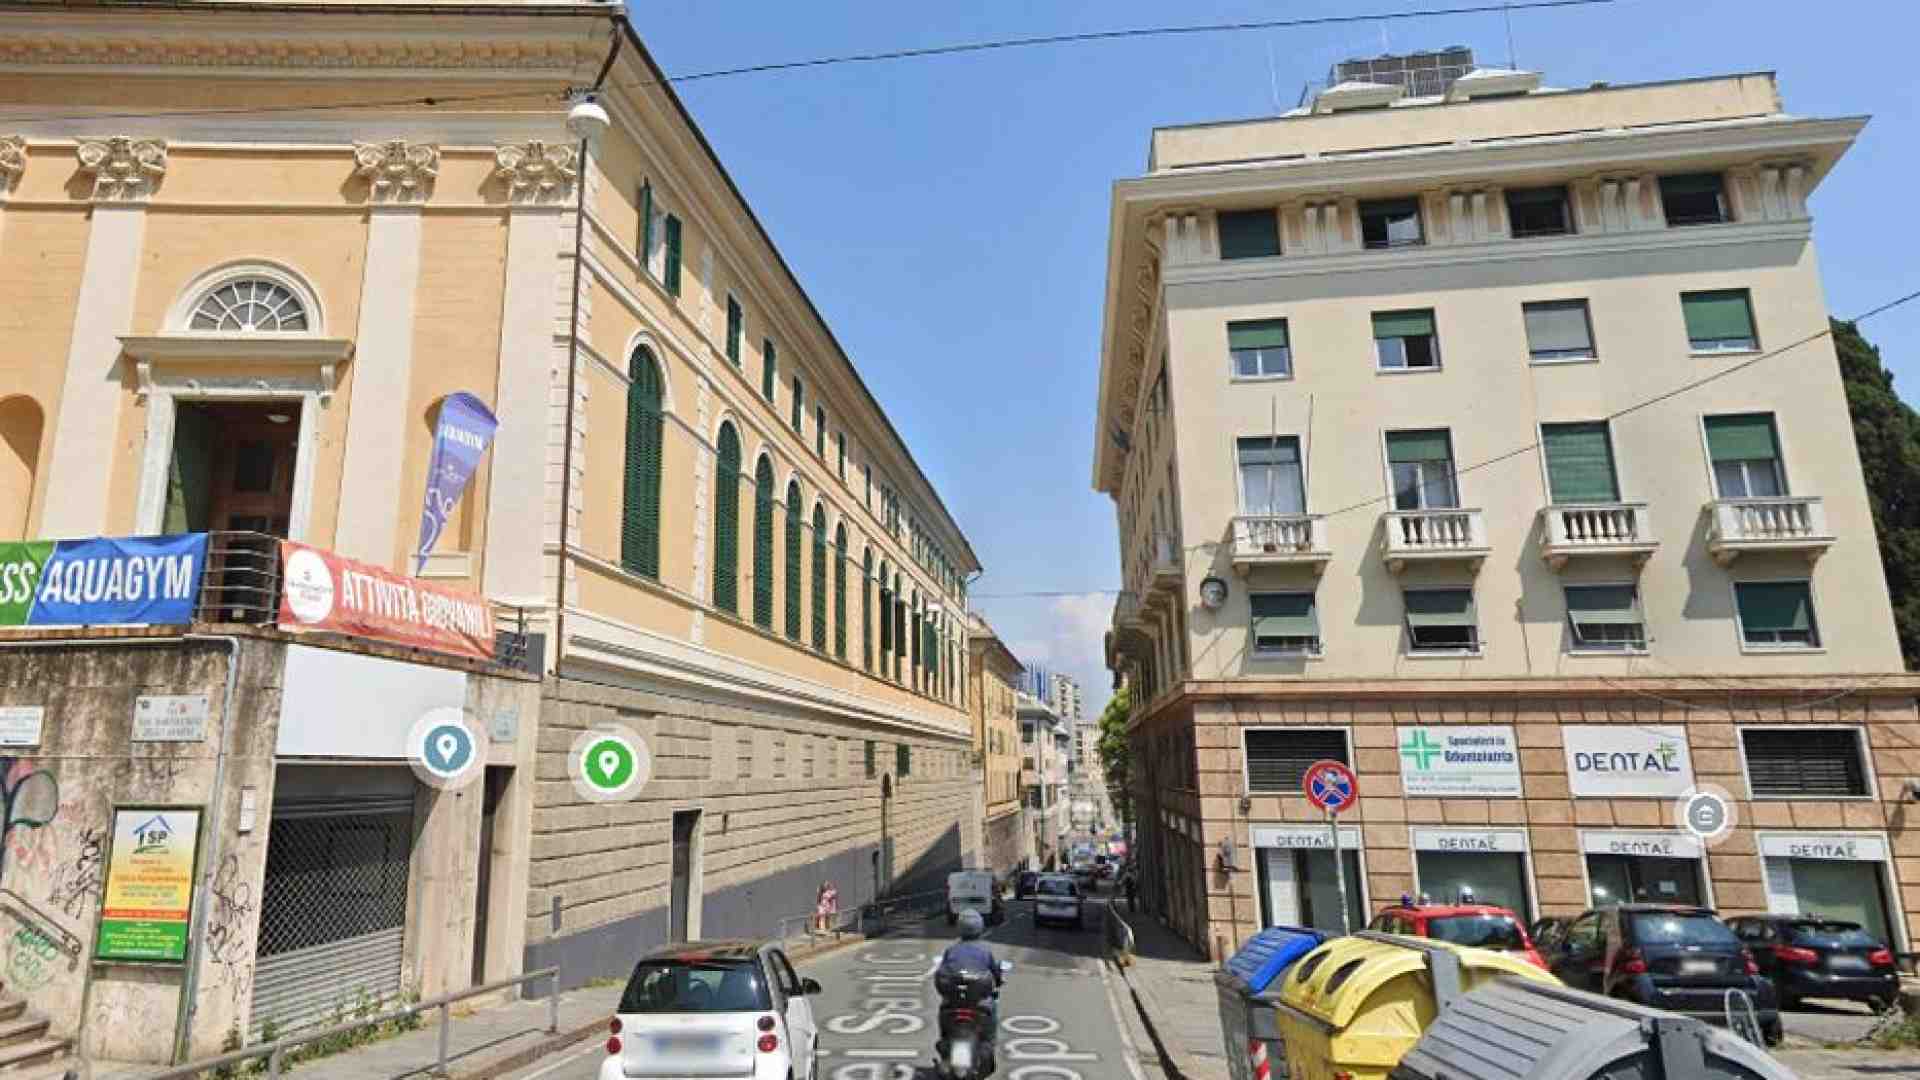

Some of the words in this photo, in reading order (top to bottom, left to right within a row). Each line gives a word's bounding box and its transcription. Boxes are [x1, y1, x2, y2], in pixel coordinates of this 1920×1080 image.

[0, 561, 37, 603] SS
[40, 554, 194, 605] AQUAGYM
[341, 567, 420, 623] ATTIVITÀ
[1575, 751, 1680, 773] DENTAL
[1610, 840, 1673, 855] DENTAL
[1790, 843, 1858, 858] DENTAL
